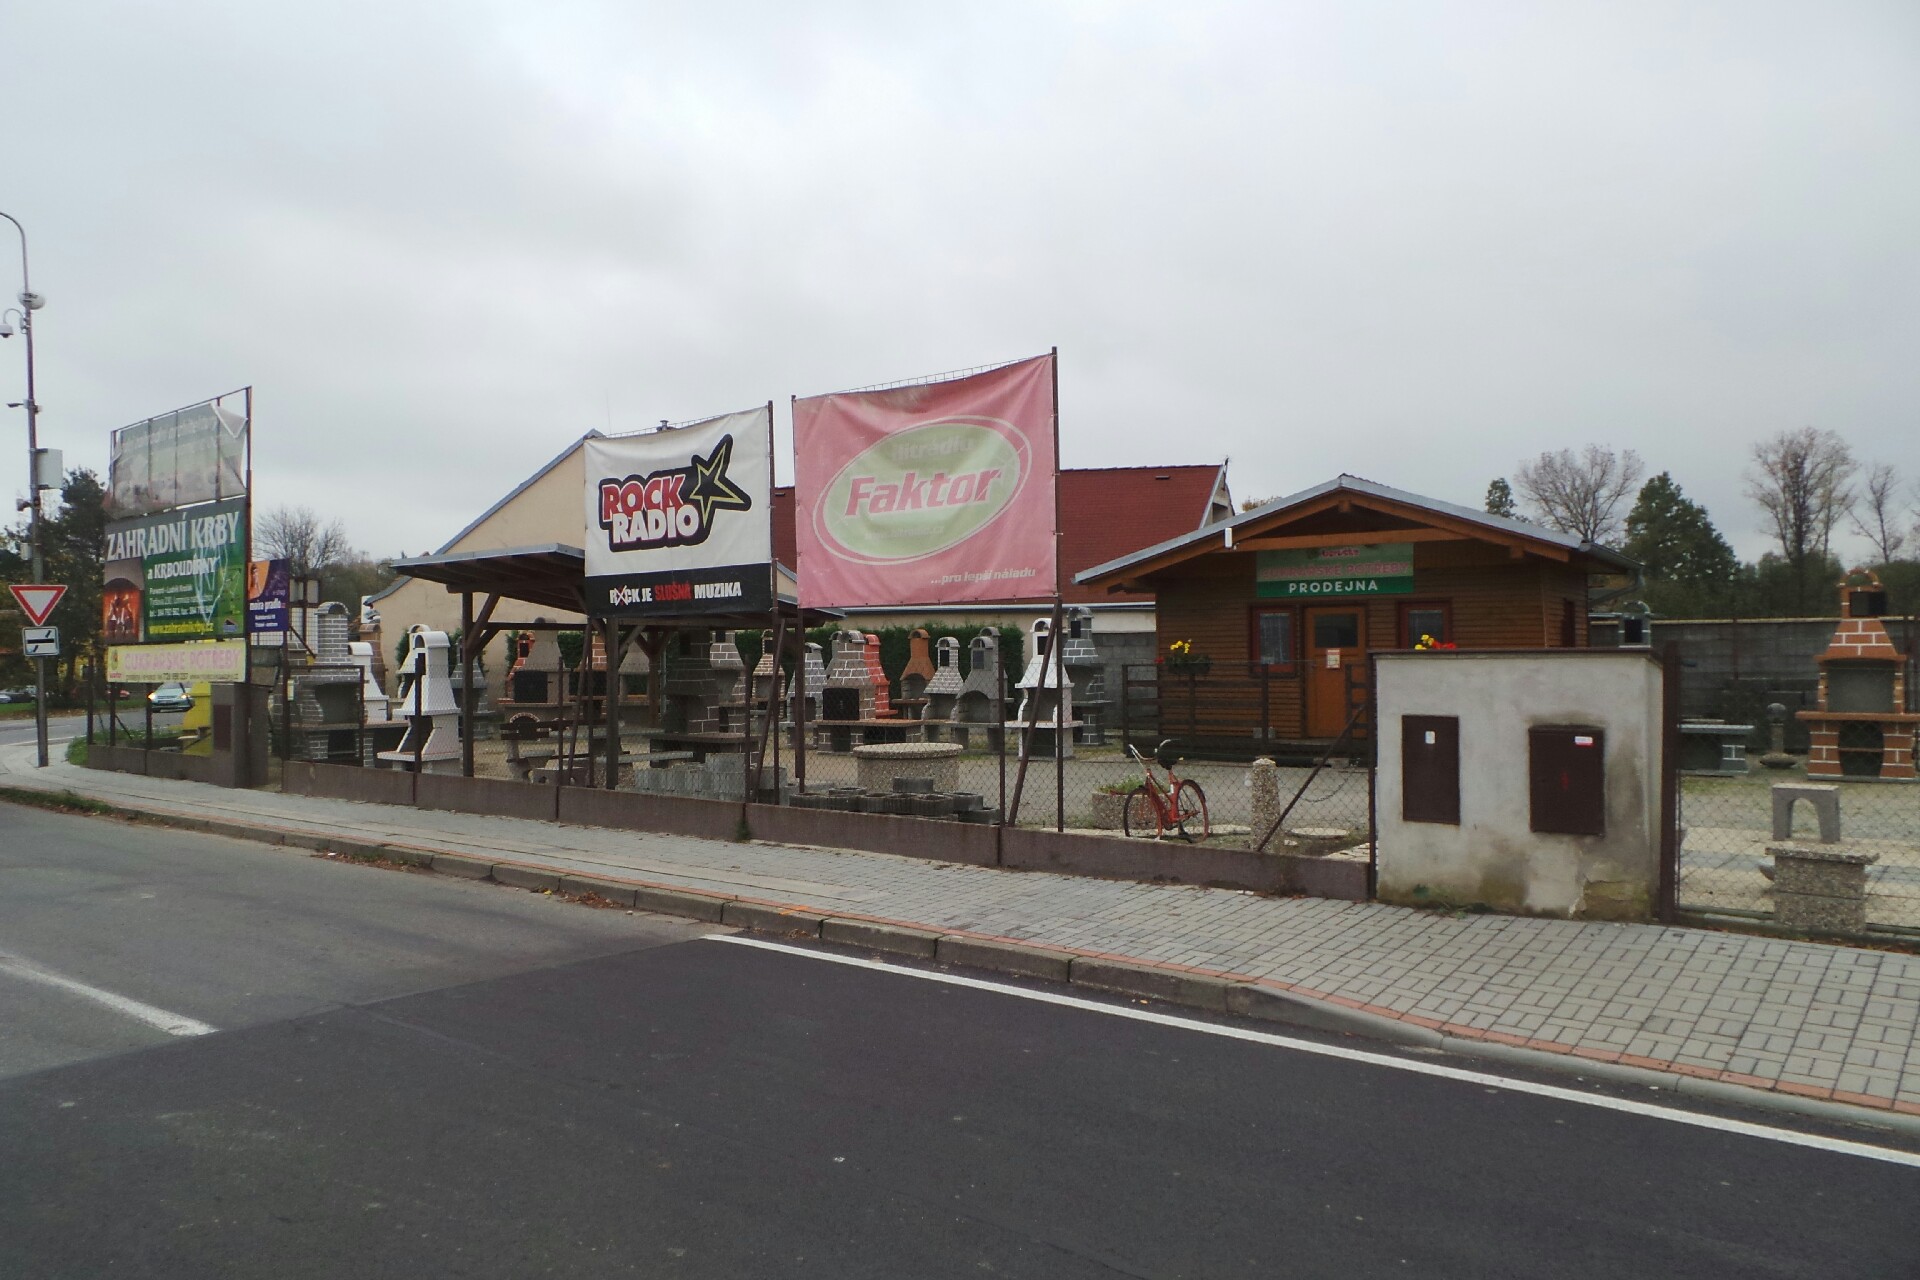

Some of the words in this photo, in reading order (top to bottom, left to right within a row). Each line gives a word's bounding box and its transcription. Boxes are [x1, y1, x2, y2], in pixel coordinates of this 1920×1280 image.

[602, 474, 686, 523] ROCK
[844, 468, 1002, 517] Faktor
[107, 512, 188, 561] ZAHRADNÍ
[190, 512, 240, 550] KRBY
[612, 504, 700, 544] RADIO
[147, 568, 153, 580] a
[994, 567, 1036, 579] náladu
[1288, 580, 1379, 594] PRODEJNA
[641, 587, 653, 602] JE
[694, 581, 742, 599] MUZIKA
